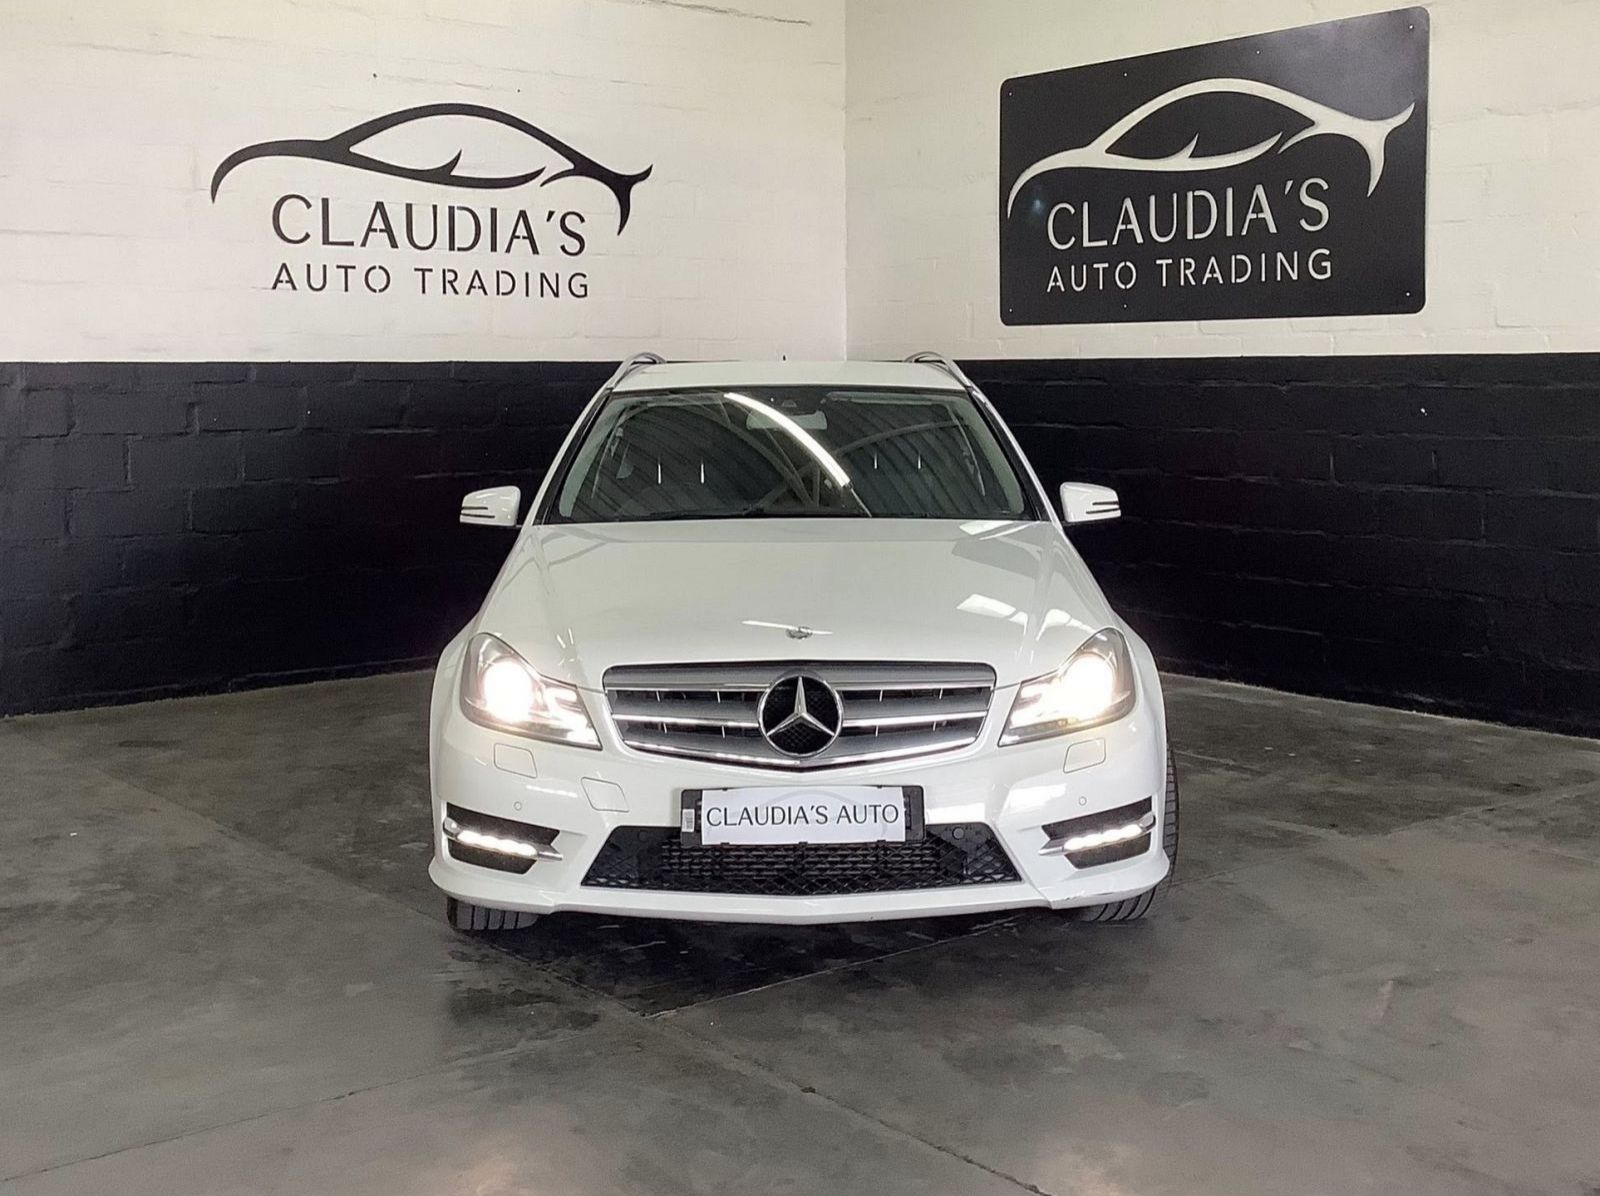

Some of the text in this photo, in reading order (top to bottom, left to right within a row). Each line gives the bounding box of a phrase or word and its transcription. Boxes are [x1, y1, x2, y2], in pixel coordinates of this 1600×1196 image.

[271, 193, 587, 257] CLAUDIA'S
[1046, 176, 1330, 250] CLAUDIA'S
[270, 261, 589, 298] AUTO TRADING
[1046, 248, 1332, 293] AUTO TRADING
[706, 804, 829, 827] CLAUDIA'S
[836, 803, 899, 825] AUTO
